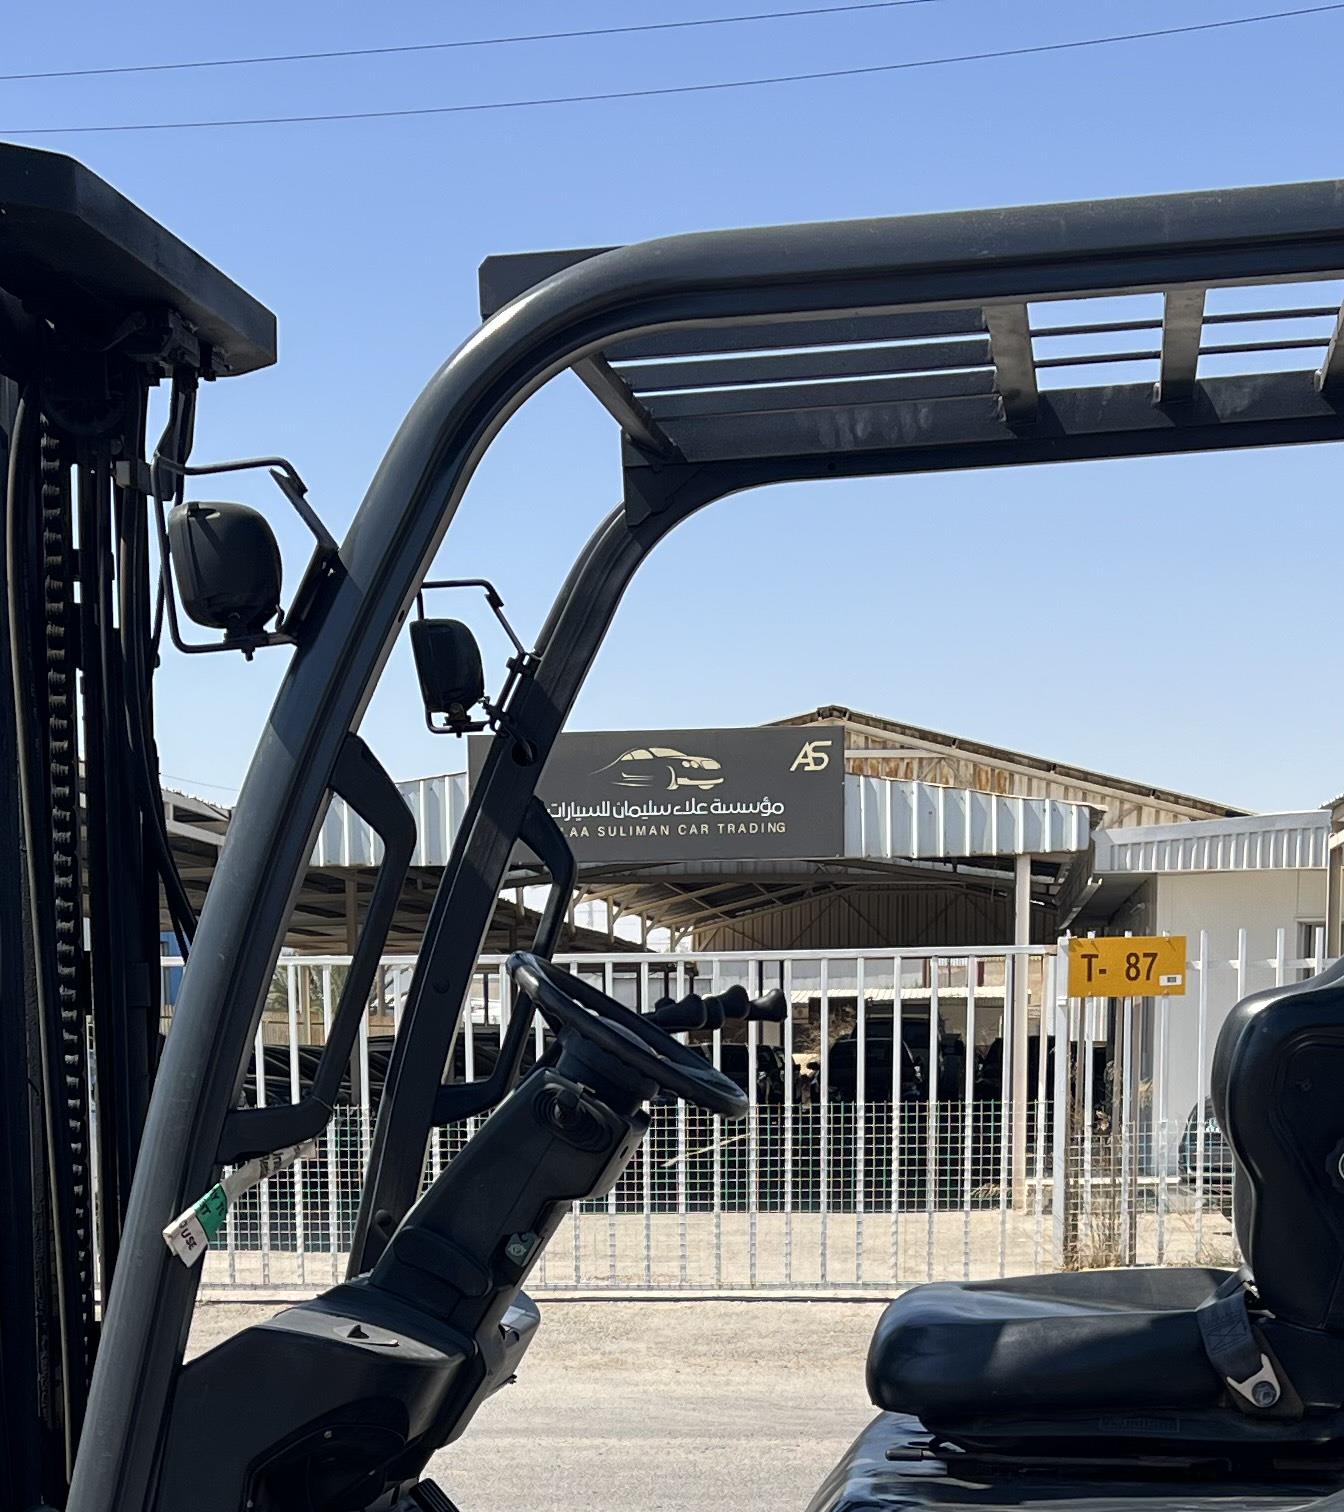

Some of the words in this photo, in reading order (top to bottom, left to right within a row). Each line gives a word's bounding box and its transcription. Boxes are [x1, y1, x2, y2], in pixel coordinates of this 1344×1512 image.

[789, 740, 833, 772] AS
[547, 800, 611, 822] للسيارات
[612, 800, 672, 820] سليمان
[673, 797, 709, 815] علاء
[710, 796, 785, 817] مؤسسة
[597, 824, 670, 838] SULIMAN
[677, 823, 710, 836] CAR
[717, 822, 786, 835] TRADING
[1125, 952, 1159, 982] 87
